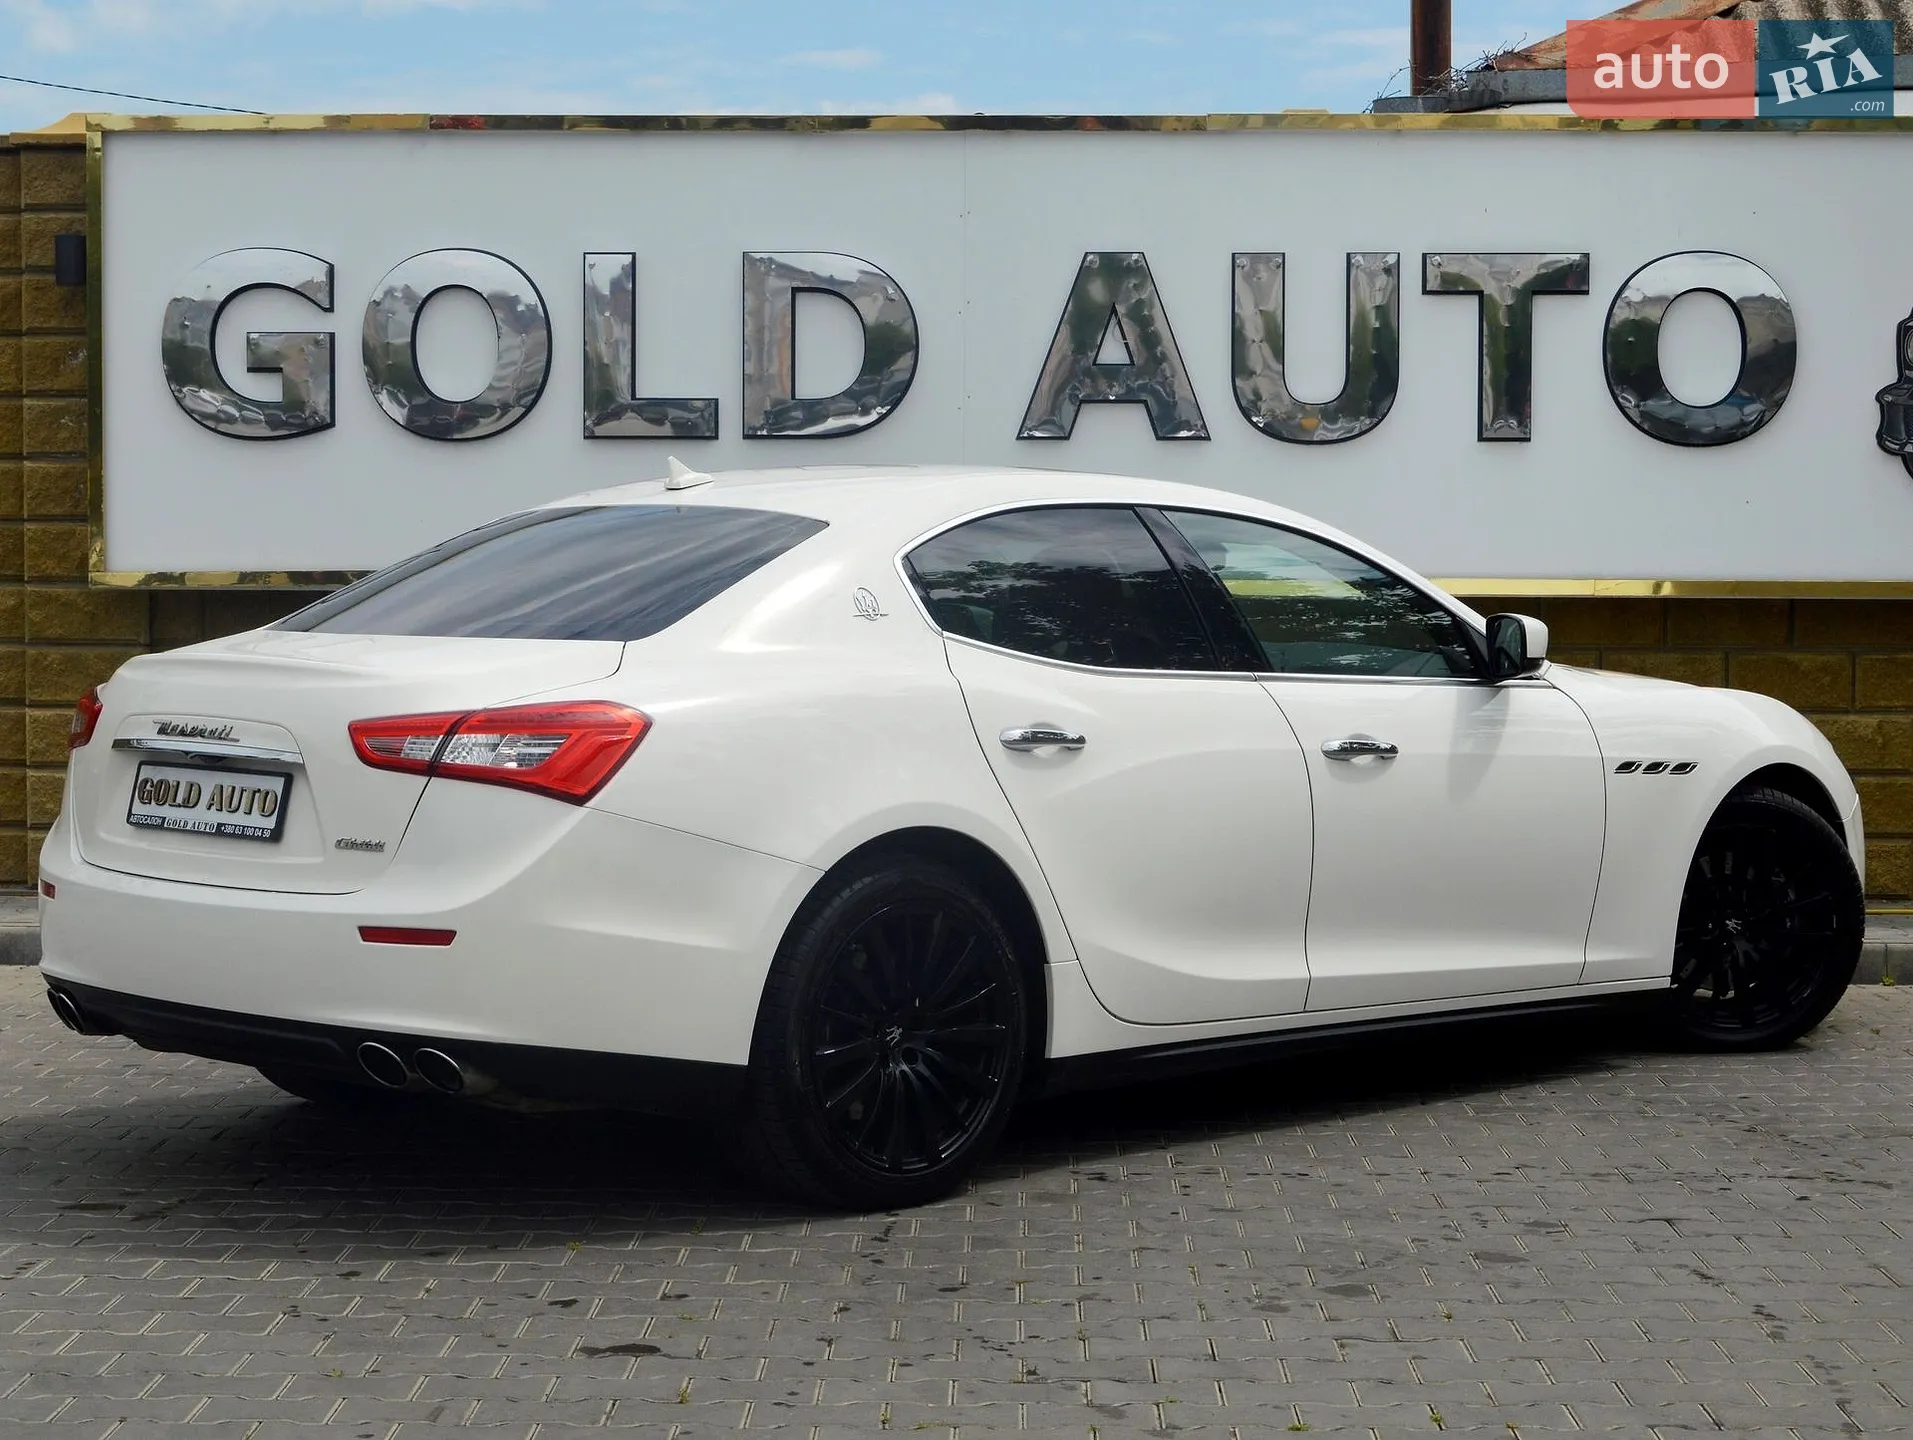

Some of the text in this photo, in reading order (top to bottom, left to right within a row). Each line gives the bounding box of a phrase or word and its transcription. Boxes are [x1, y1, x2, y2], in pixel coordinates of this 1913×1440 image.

[162, 247, 1798, 447] GOLD AUTO
[137, 777, 278, 818] GOLD AUTO
[166, 818, 189, 829] GOLD
[191, 821, 216, 832] AUTO
